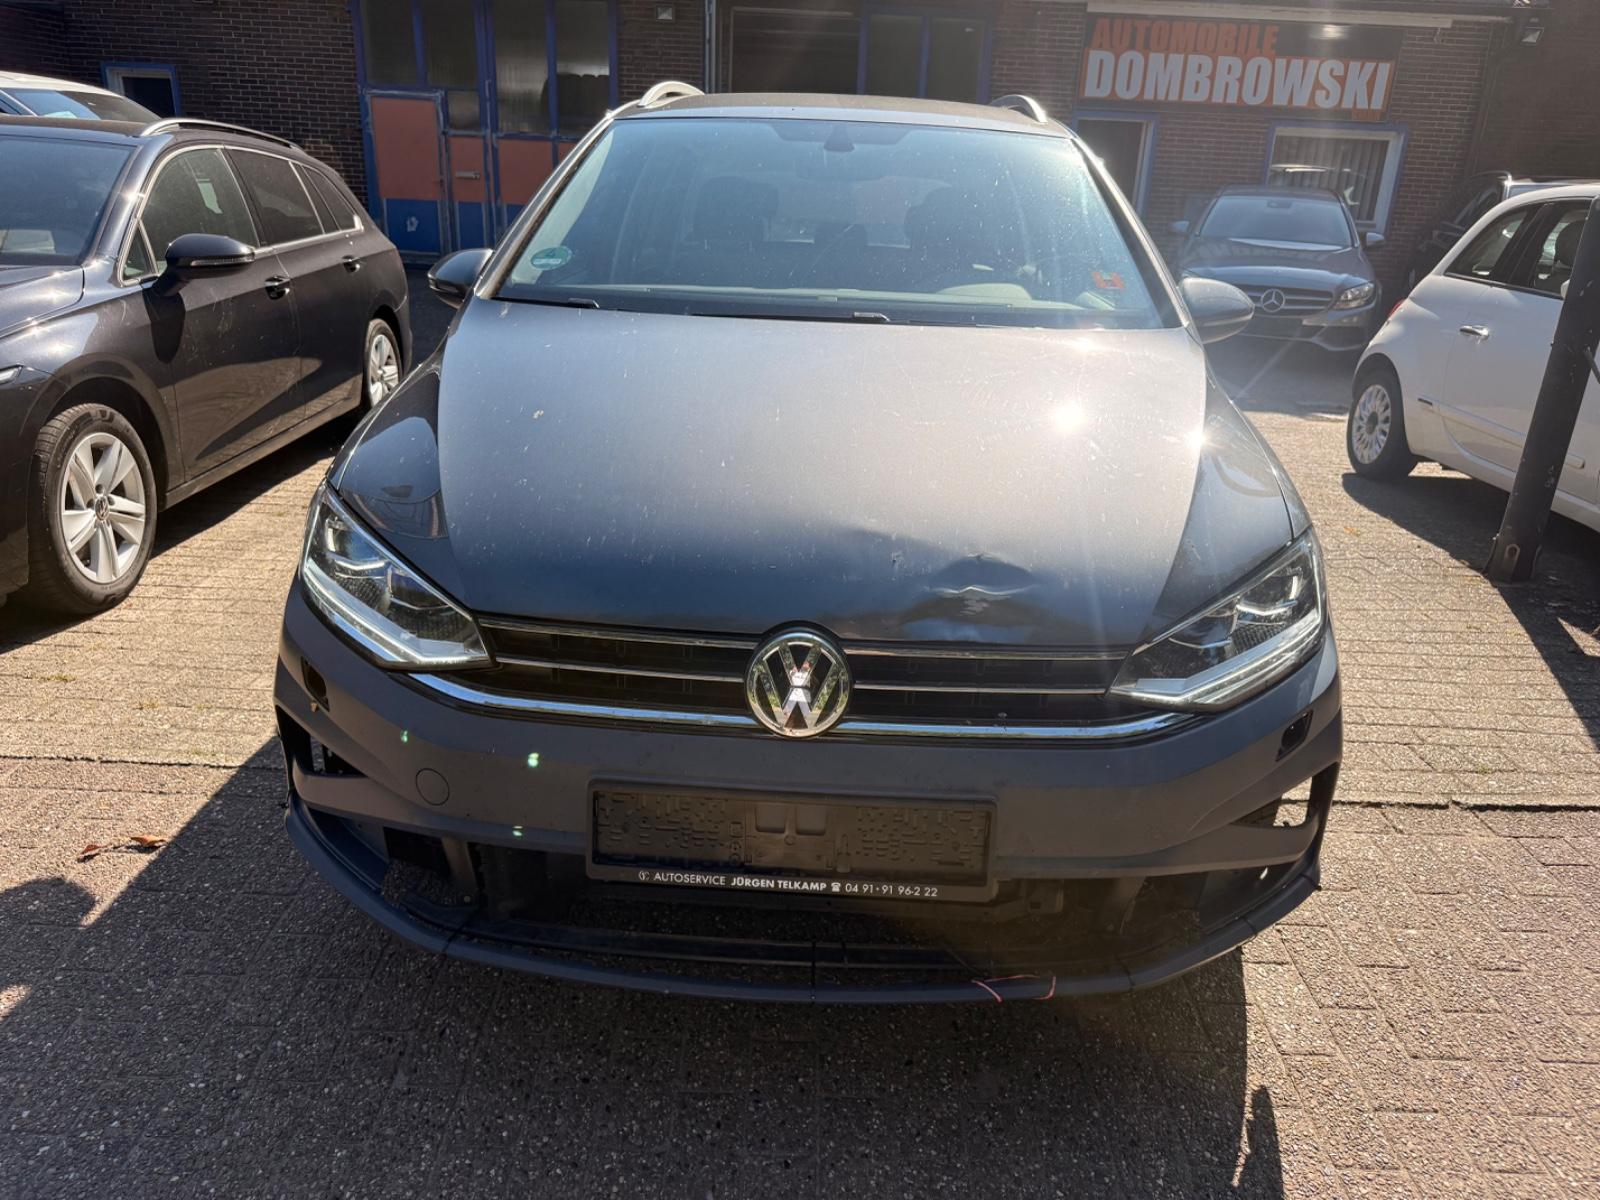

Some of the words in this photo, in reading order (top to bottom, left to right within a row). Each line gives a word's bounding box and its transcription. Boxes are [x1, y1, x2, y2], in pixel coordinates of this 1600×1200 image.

[1091, 18, 1280, 55] AUTOMOBILE
[1084, 50, 1390, 109] DOMBROWSKI
[653, 872, 726, 885] AUTOSERVICE
[731, 876, 775, 888] JÜRGEN
[777, 879, 827, 891] TELKAMP
[845, 883, 858, 893] 04
[924, 887, 938, 897] 22
